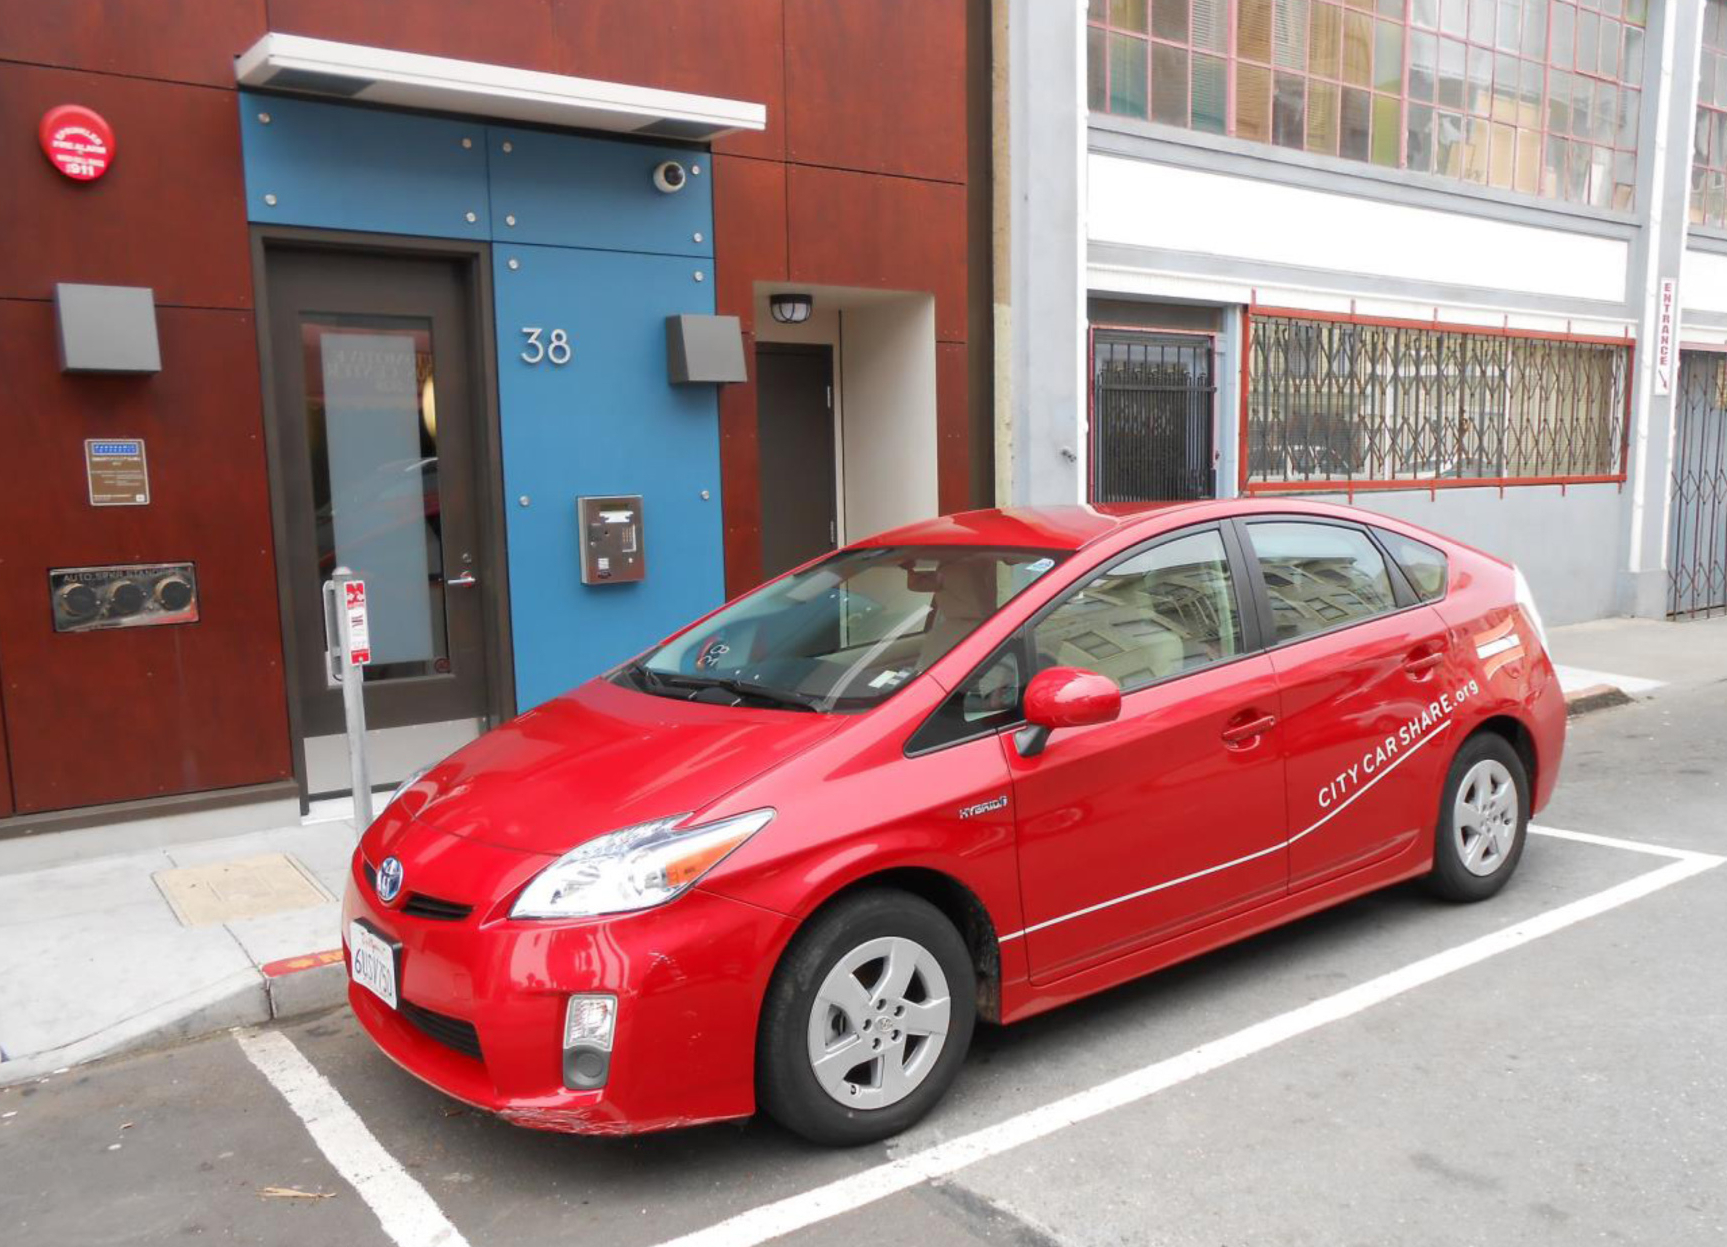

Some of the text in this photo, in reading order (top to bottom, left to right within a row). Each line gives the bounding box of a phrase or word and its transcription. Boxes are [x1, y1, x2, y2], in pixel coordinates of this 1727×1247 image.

[71, 163, 94, 176] 911
[521, 327, 571, 364] 38
[1660, 282, 1671, 366] ENTRANCE
[1318, 679, 1479, 808] CITY CAR SHARE.org
